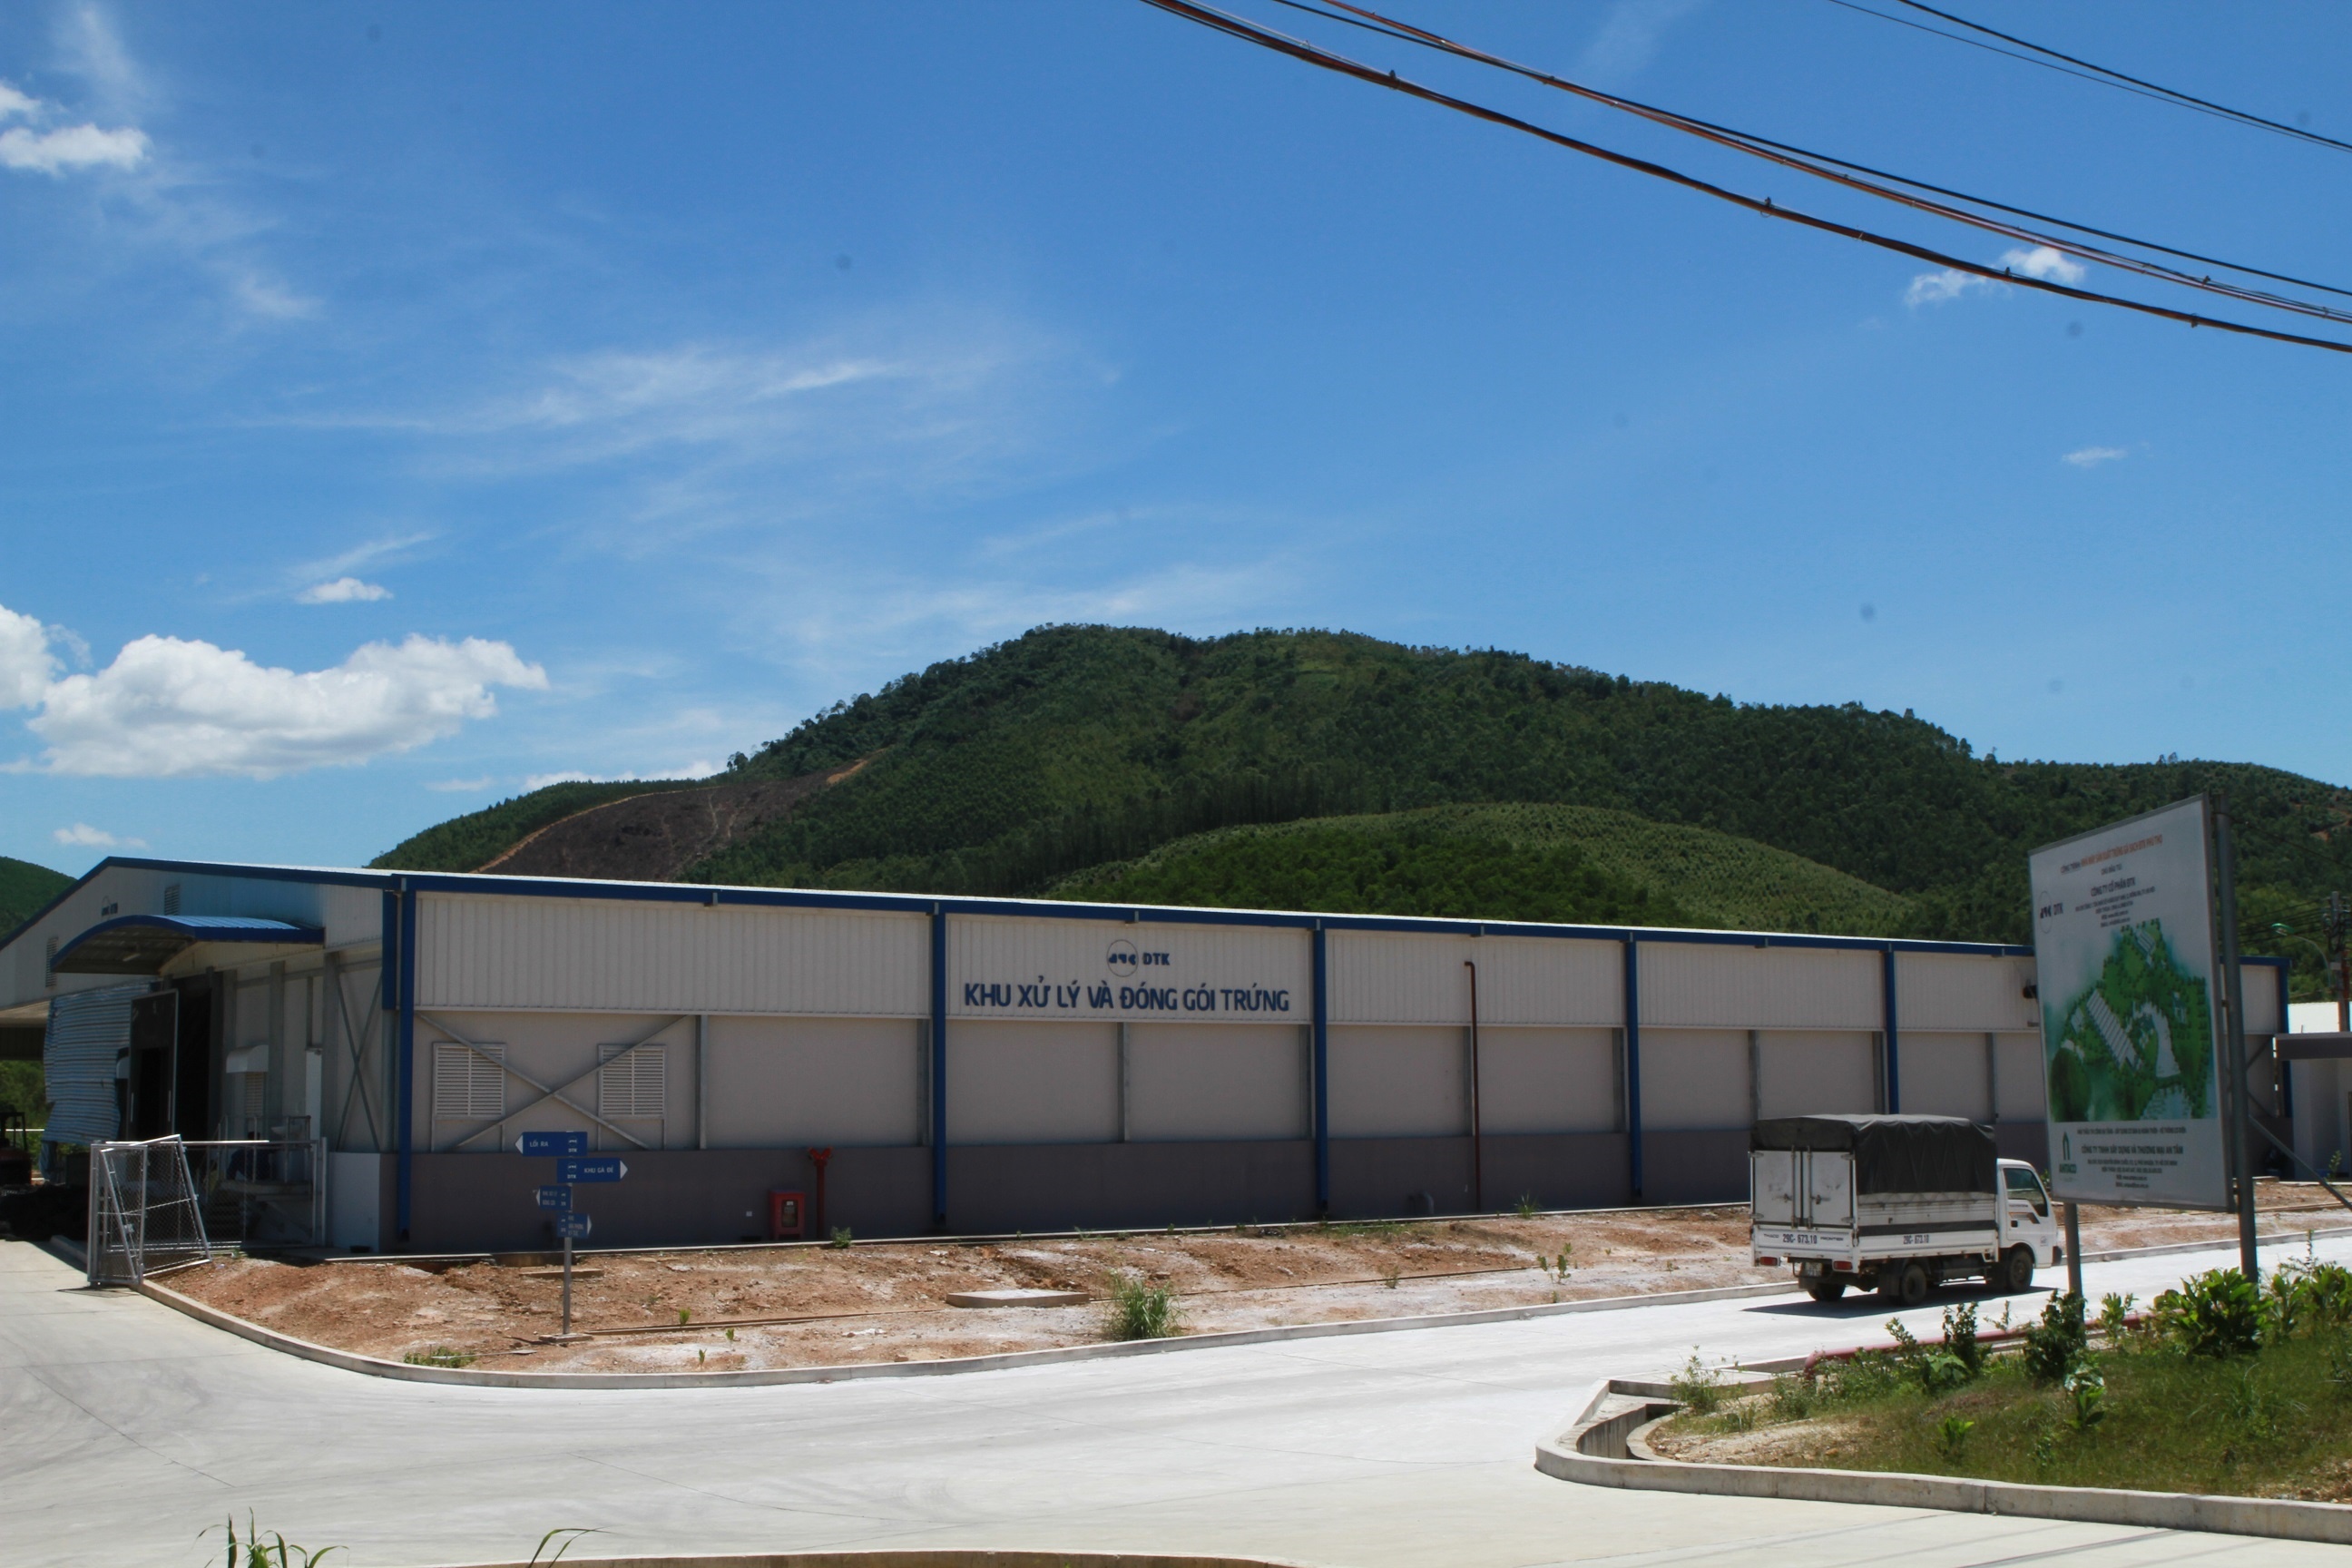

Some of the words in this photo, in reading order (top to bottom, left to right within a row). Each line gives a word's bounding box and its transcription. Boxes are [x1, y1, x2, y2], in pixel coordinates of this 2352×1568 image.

[965, 983, 1011, 1007] KHU
[1018, 975, 1051, 1008] XỬ
[1057, 979, 1081, 1008] LÝ
[1087, 980, 1114, 1009] VÀ
[1119, 981, 1178, 1010] ĐÓNG
[1182, 983, 1216, 1011] GÓI
[1220, 983, 1289, 1012] TRỨNG
